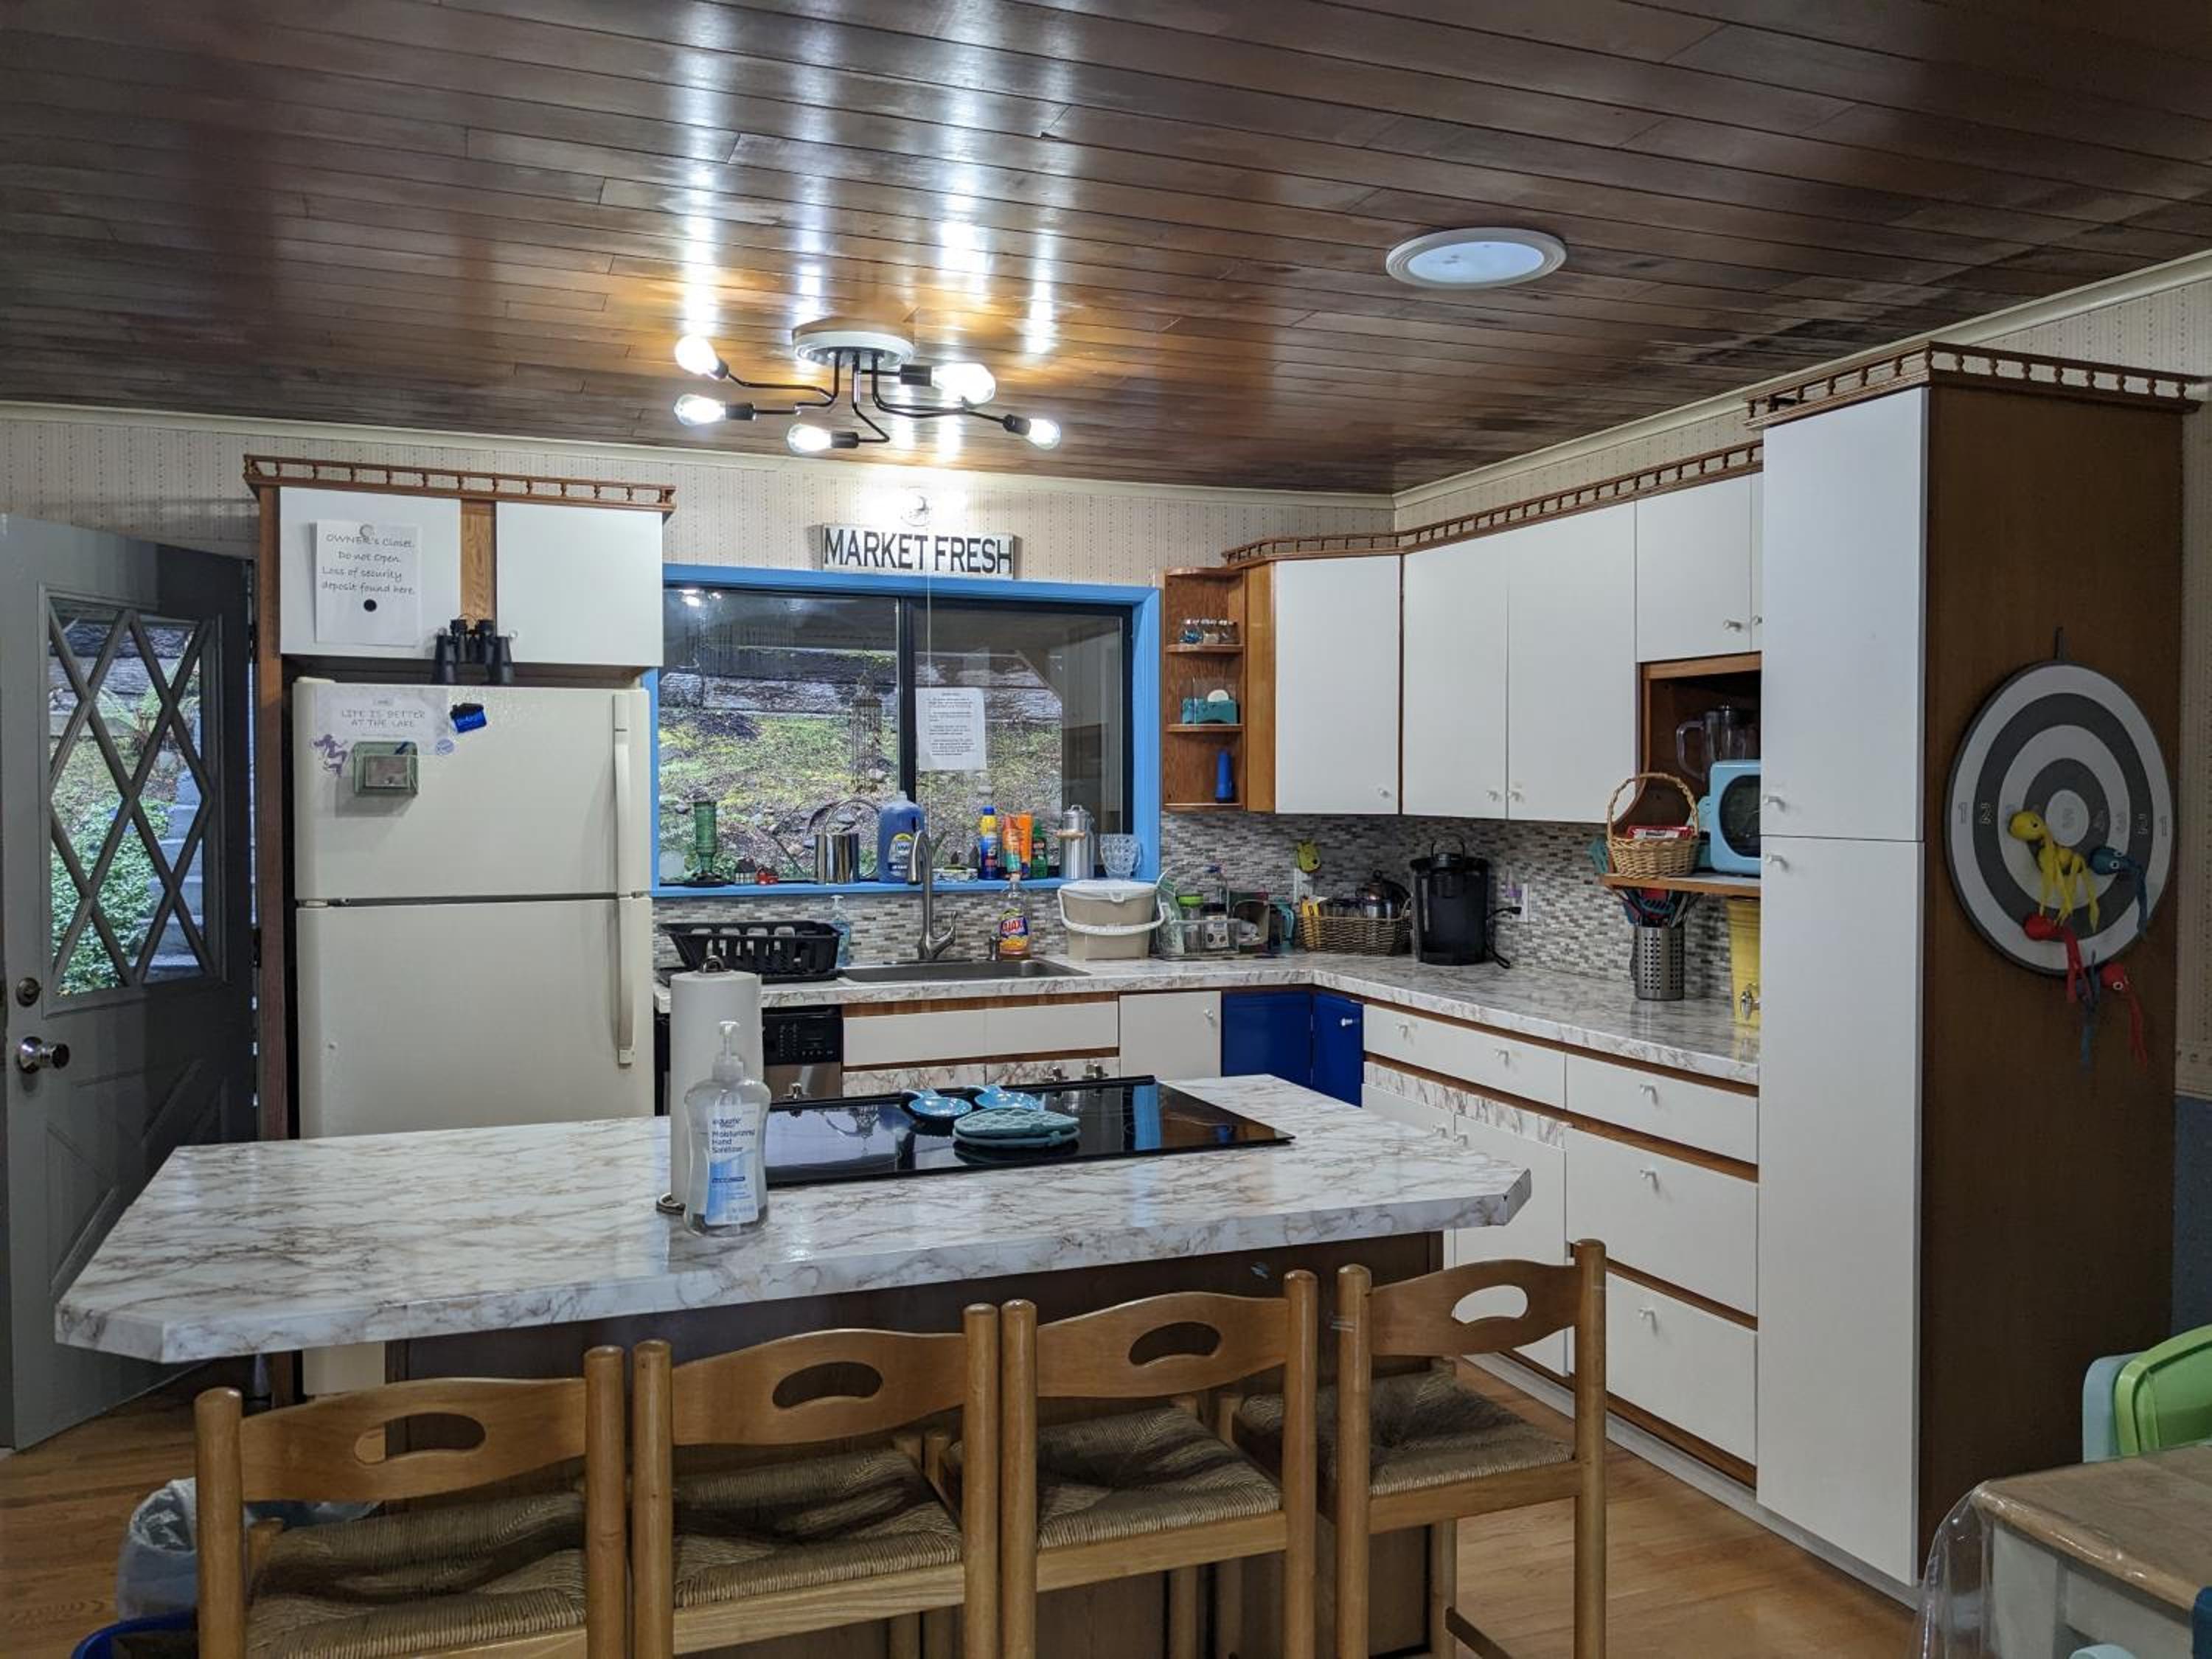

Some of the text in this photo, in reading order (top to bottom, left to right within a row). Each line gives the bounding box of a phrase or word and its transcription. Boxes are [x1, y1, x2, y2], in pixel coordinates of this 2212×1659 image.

[338, 550, 352, 560] Do
[354, 553, 372, 561] not
[824, 528, 1012, 574] MARKET FRESH
[322, 566, 402, 582] Loss of security
[321, 580, 357, 594] deposit
[360, 582, 390, 596] found
[341, 710, 425, 719] LIFE IS BETTER
[367, 719, 387, 727] THE
